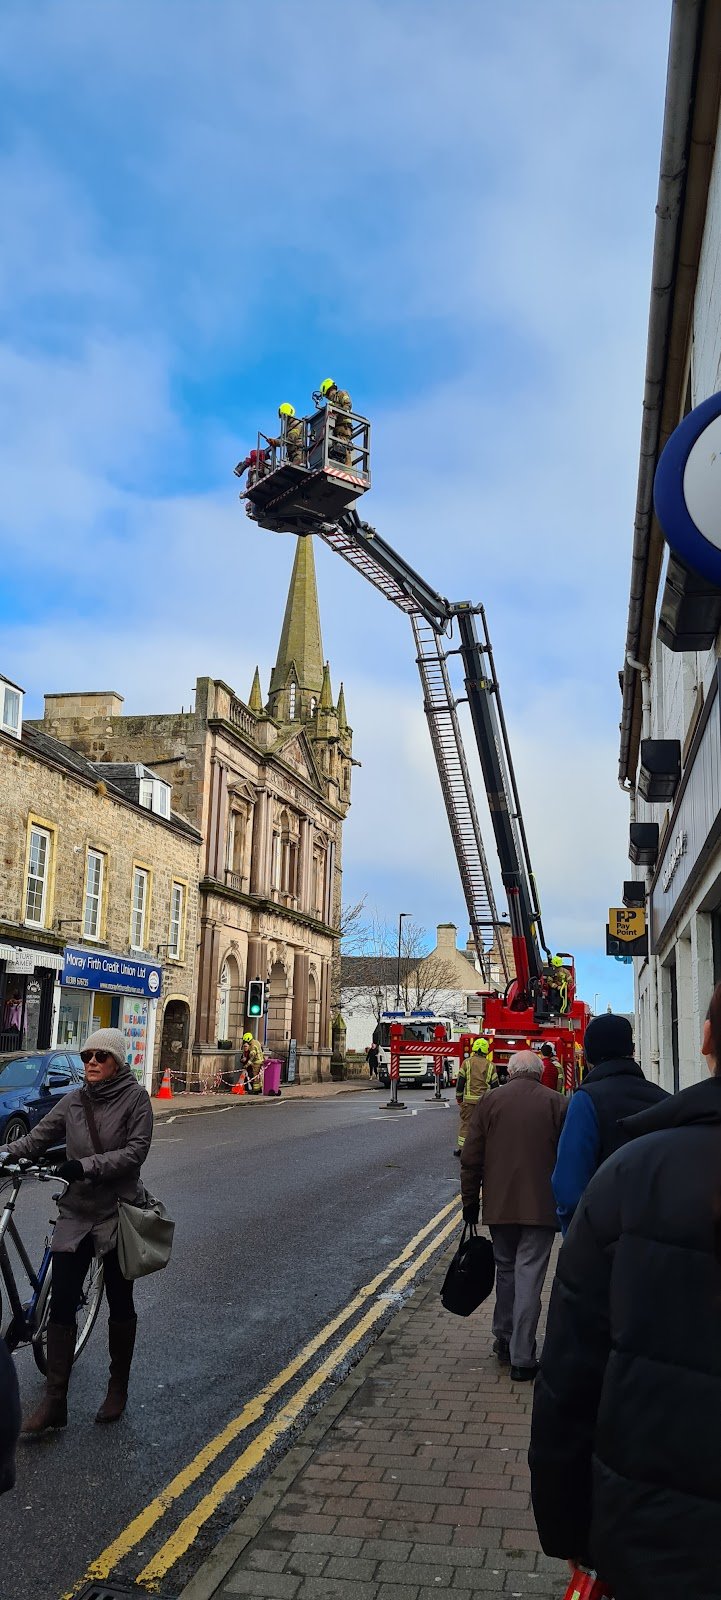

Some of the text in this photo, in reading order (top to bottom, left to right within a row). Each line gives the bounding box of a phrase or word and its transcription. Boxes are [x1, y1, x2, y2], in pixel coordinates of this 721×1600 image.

[66, 952, 146, 978] Moray Firth Credit Union Ltd
